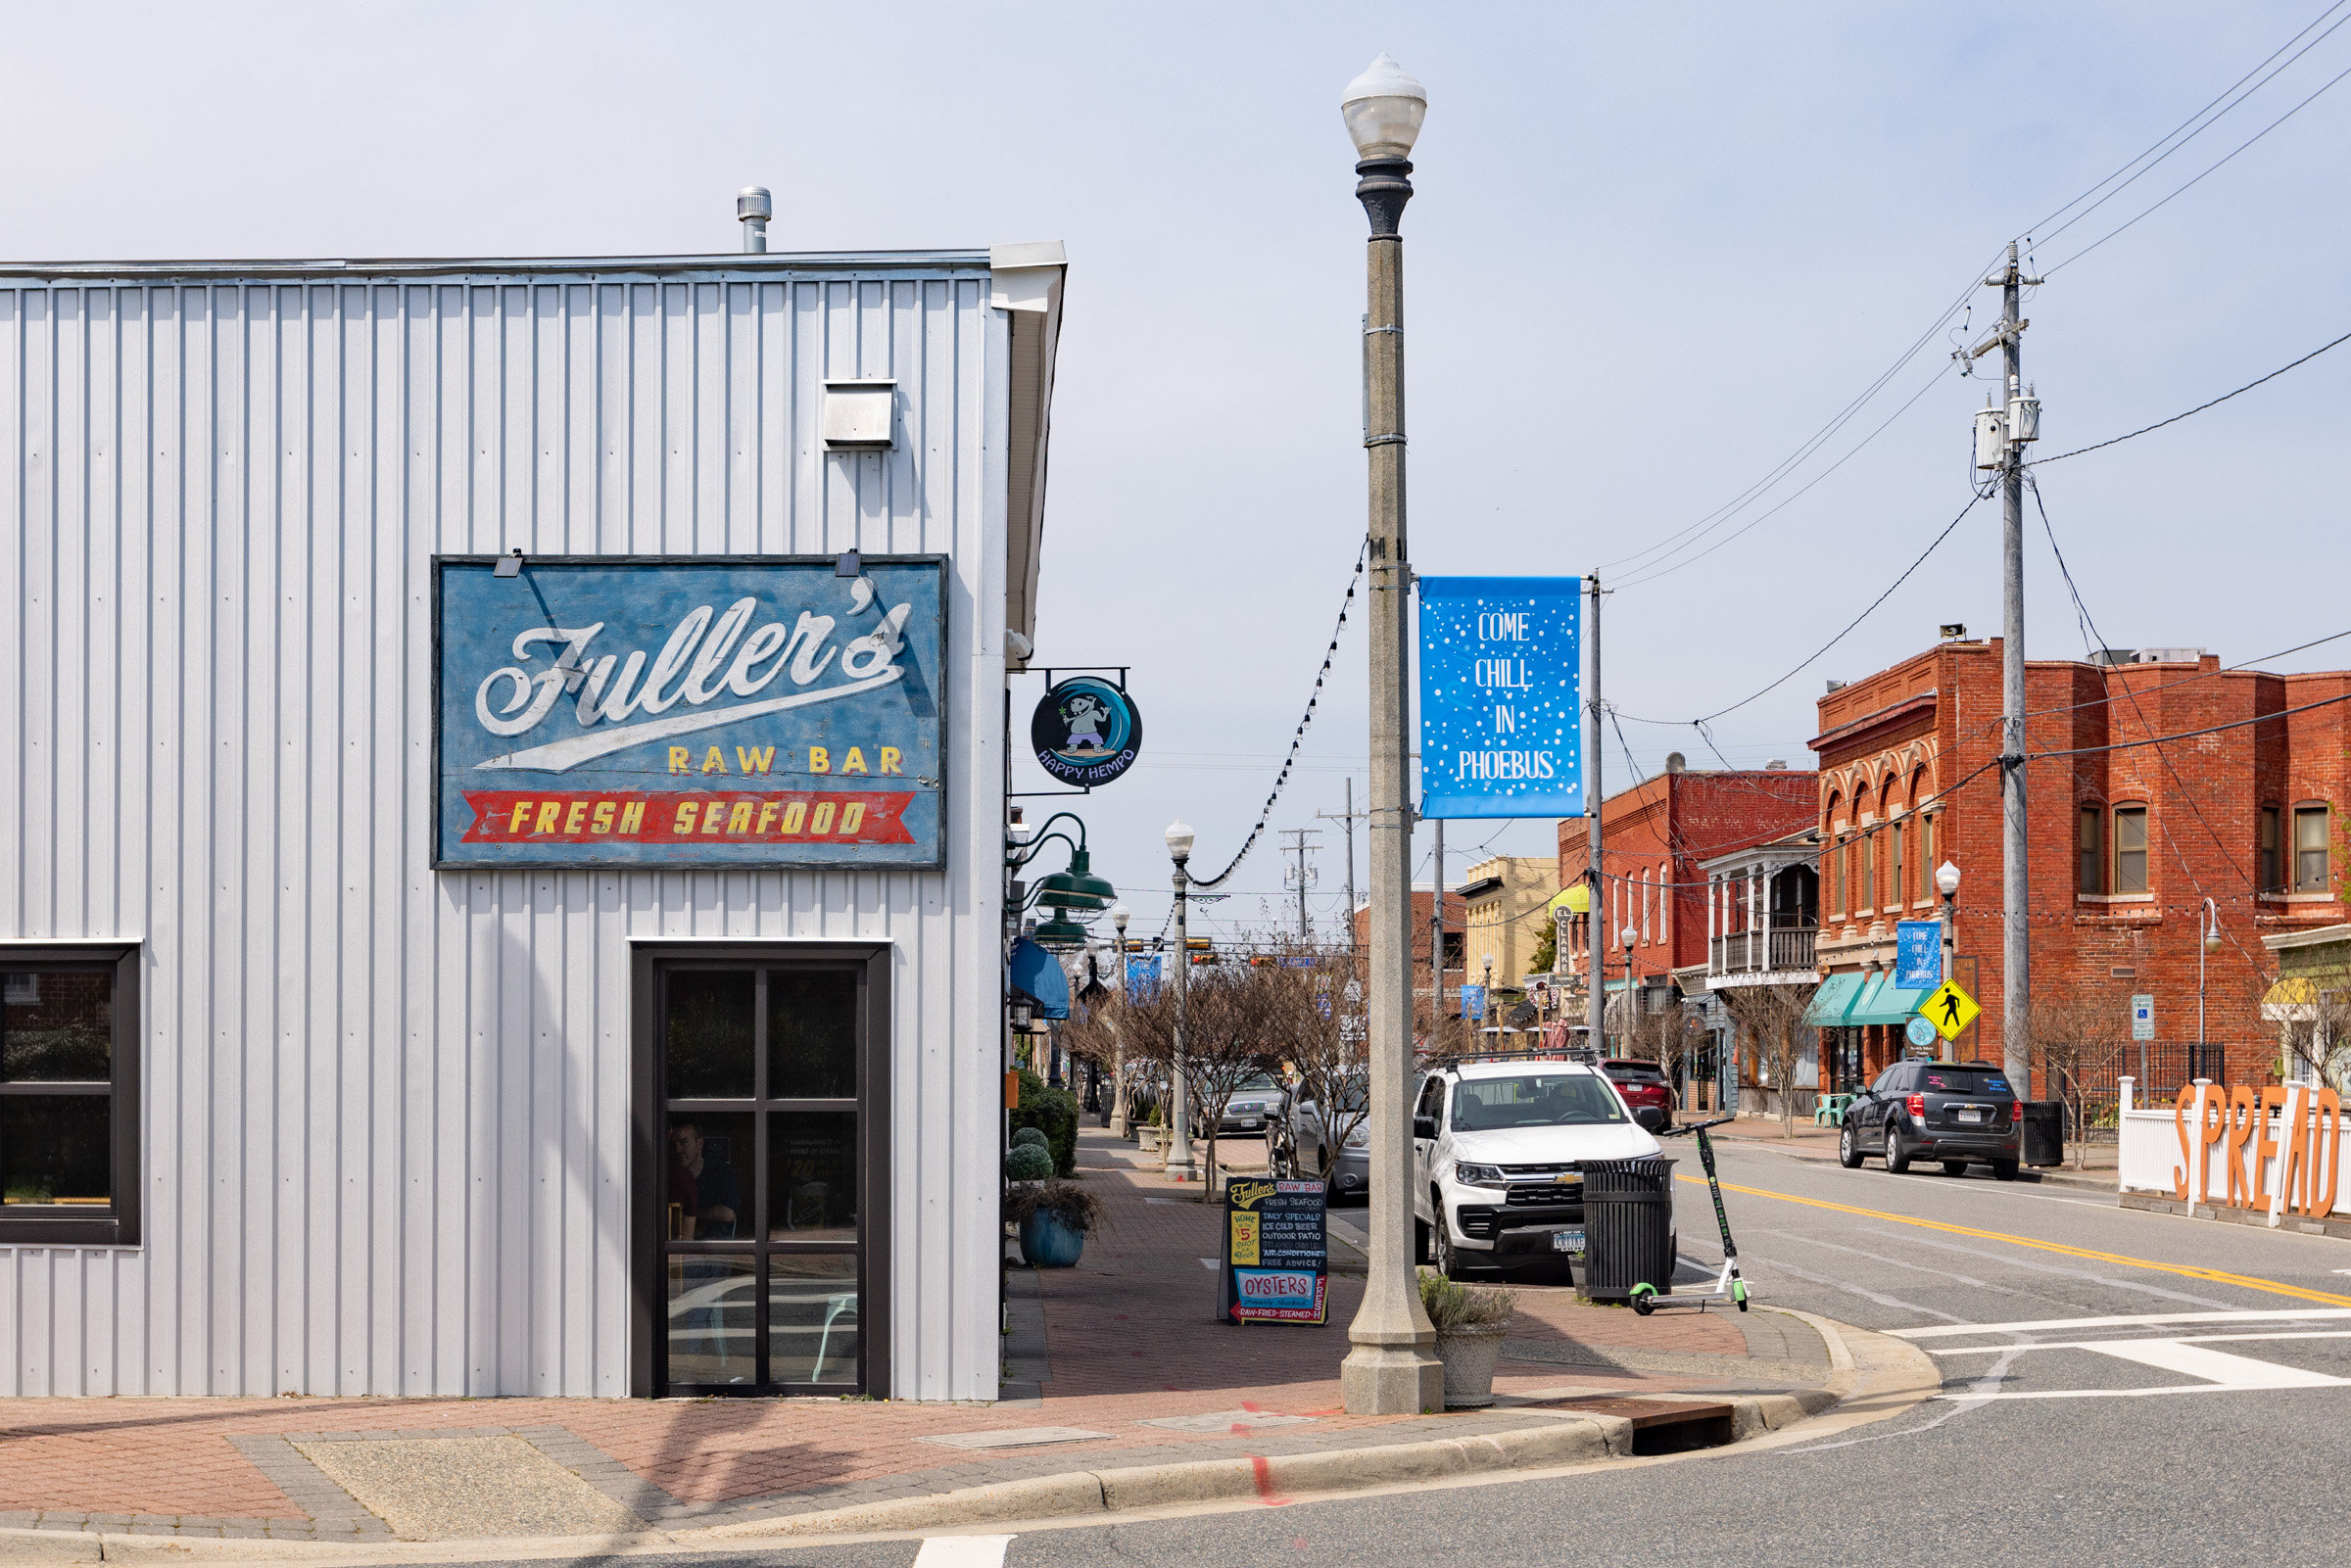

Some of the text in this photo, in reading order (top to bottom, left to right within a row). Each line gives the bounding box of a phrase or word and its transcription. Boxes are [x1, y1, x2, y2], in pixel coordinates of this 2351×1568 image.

[1478, 612, 1530, 641] COME
[475, 577, 913, 738] Fuller's
[1475, 658, 1534, 688] CHILL
[1496, 704, 1515, 734] IN
[668, 745, 905, 777] RAW BAR
[1037, 748, 1134, 779] HAPPY HEMPO
[1459, 750, 1555, 780] PHOEBUS
[508, 801, 868, 835] FRESH SEAFOOD
[1905, 970, 1934, 979] PHOEBUS
[2174, 1084, 2340, 1218] SPREAD
[1230, 1181, 1276, 1205] Fuller's
[1265, 1198, 1322, 1207] FRESH SEAFOOD
[1304, 1183, 1322, 1192] BAR
[1234, 1214, 1256, 1223] HOME
[1236, 1239, 1256, 1249] SHOT
[1245, 1276, 1307, 1295] OYSTERS
[1314, 1278, 1325, 1319] FRESH
